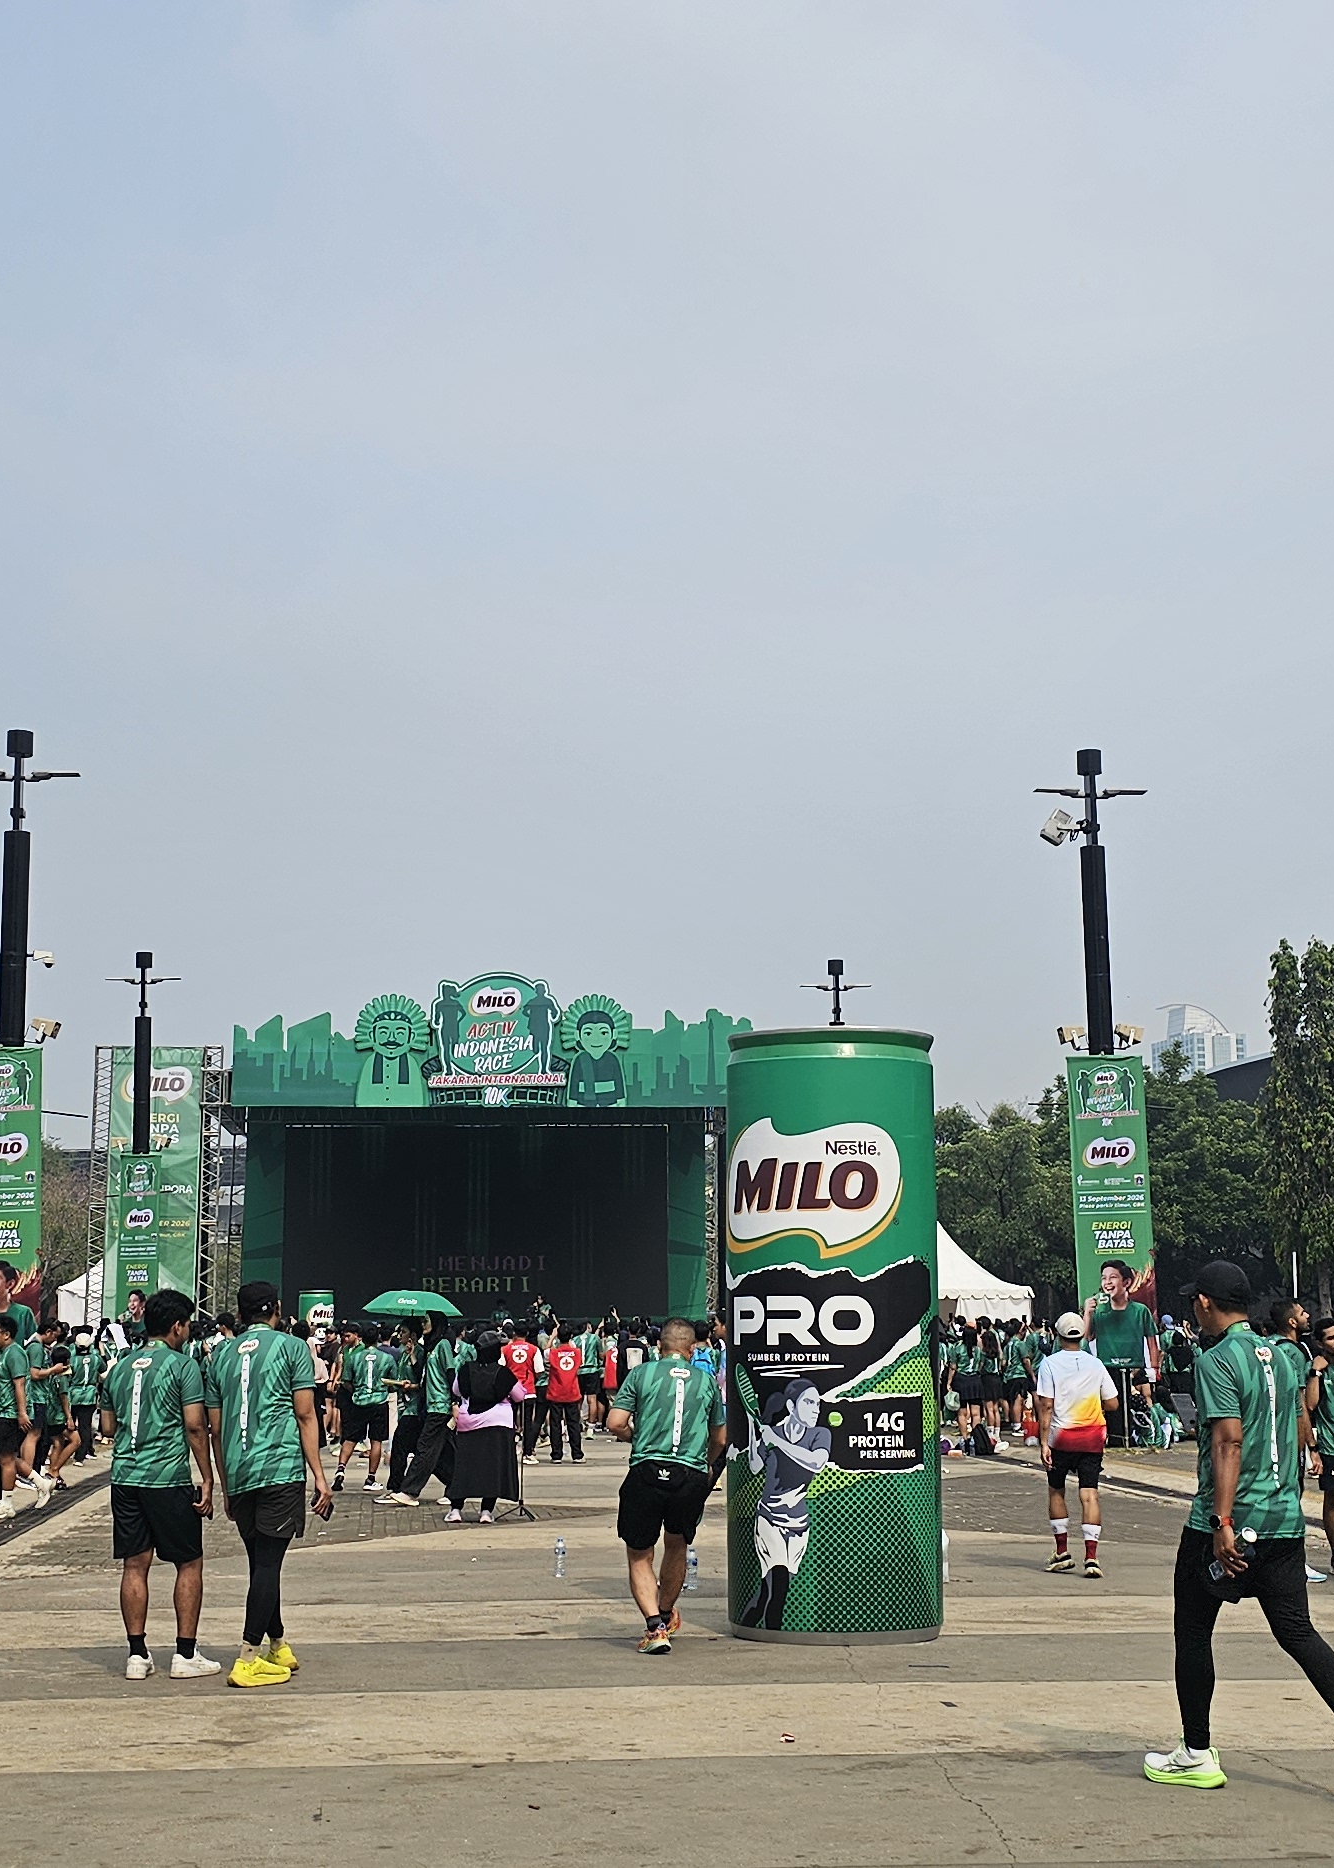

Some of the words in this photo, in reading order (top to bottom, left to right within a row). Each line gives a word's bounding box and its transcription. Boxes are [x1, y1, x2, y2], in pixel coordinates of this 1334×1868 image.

[477, 996, 515, 1008] MILO
[467, 1020, 518, 1039] ACTIV
[454, 1035, 533, 1058] INDONESIA
[474, 1054, 513, 1073] RACE
[151, 1077, 185, 1092] ILO
[429, 1076, 478, 1085] JAKARTA
[480, 1075, 565, 1084] INTERNATIONAL
[484, 1087, 507, 1104] 10K
[151, 1114, 180, 1123] ERGI
[151, 1124, 179, 1133] NPA
[826, 1140, 877, 1155] Nestlé
[1091, 1146, 1130, 1159] MILO
[734, 1158, 879, 1215] MILO
[129, 1215, 150, 1223] MILO
[1092, 1221, 1131, 1230] ENERGI
[1094, 1230, 1131, 1239] TANPA
[1098, 1239, 1135, 1248] BATAS
[422, 1277, 530, 1292] BERARTI
[734, 1295, 875, 1345] PRO
[747, 1353, 780, 1361] SUMBER
[784, 1353, 830, 1362] PROTEIN
[863, 1412, 904, 1431] 14G
[848, 1434, 904, 1447] PROTEIN
[860, 1450, 878, 1458] PER
[879, 1449, 916, 1458] SERVING
